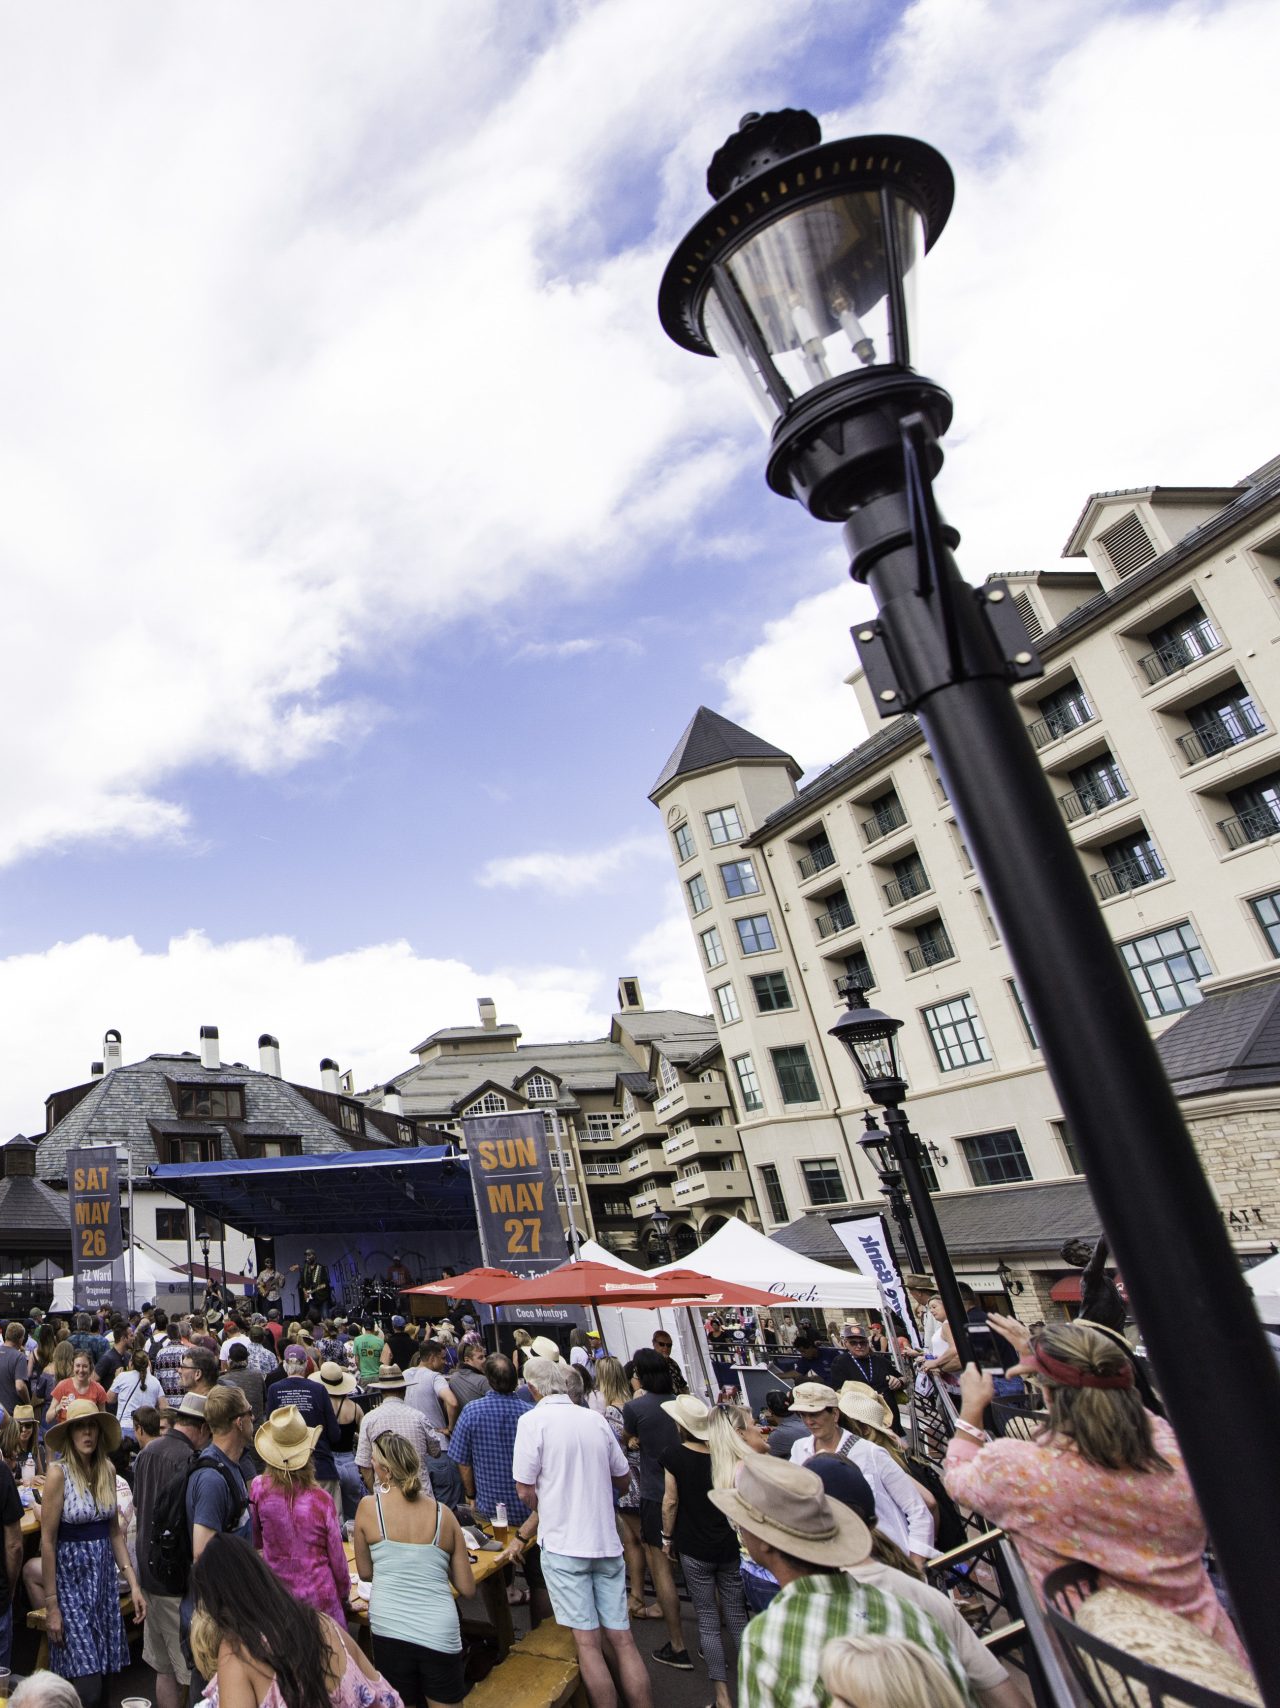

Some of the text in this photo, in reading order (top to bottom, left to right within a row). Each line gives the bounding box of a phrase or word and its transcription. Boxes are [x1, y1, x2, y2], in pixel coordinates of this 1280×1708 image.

[478, 1137, 537, 1169] SUN
[74, 1167, 109, 1191] SAT
[487, 1182, 544, 1214] MAY
[75, 1201, 111, 1225] MAY
[1221, 1208, 1263, 1224] ATT
[81, 1229, 107, 1257] 26
[504, 1218, 541, 1253] 27
[82, 1269, 112, 1281] ZZ Ward
[515, 1308, 568, 1319] Coco Montoya
